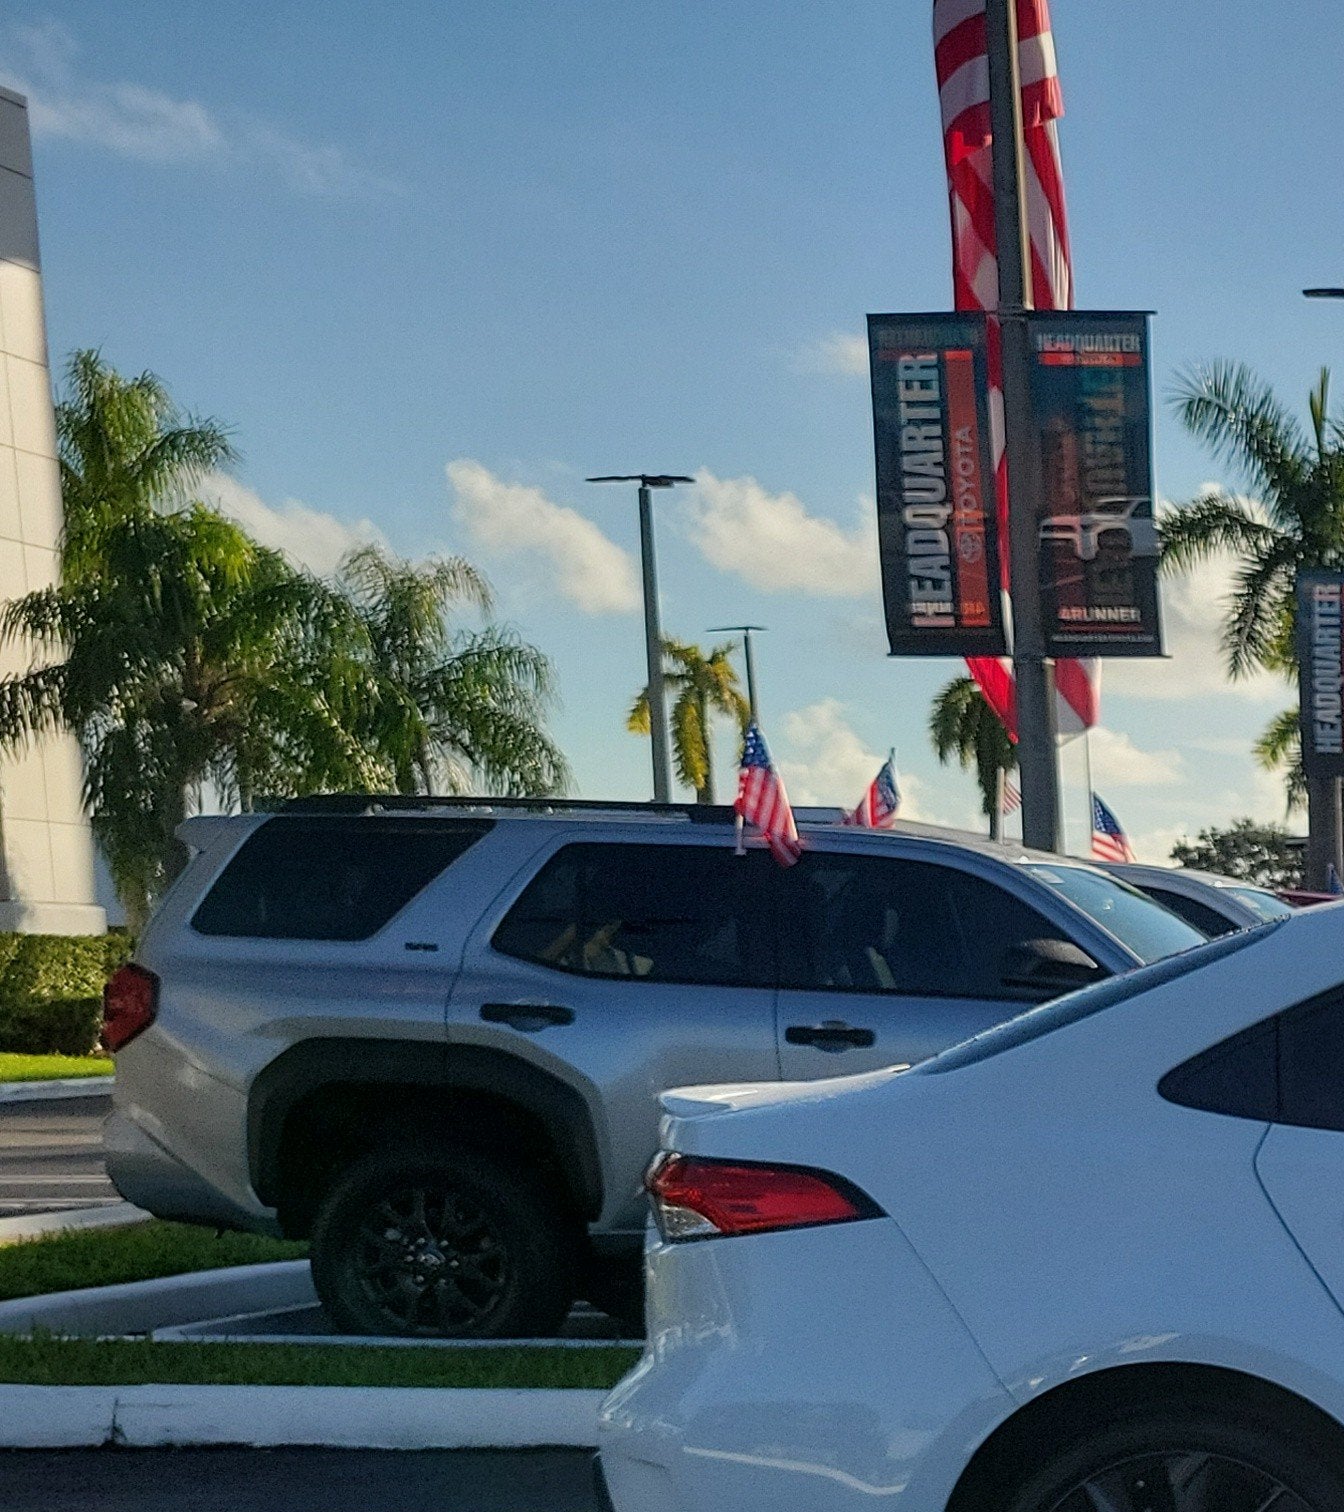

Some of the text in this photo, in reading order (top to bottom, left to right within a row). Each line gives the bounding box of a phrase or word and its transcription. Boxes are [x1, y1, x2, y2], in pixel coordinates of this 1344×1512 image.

[899, 353, 955, 628] HEADQUARTER
[954, 426, 979, 527] TOYOTA
[1313, 584, 1344, 754] HEADQUARTER
